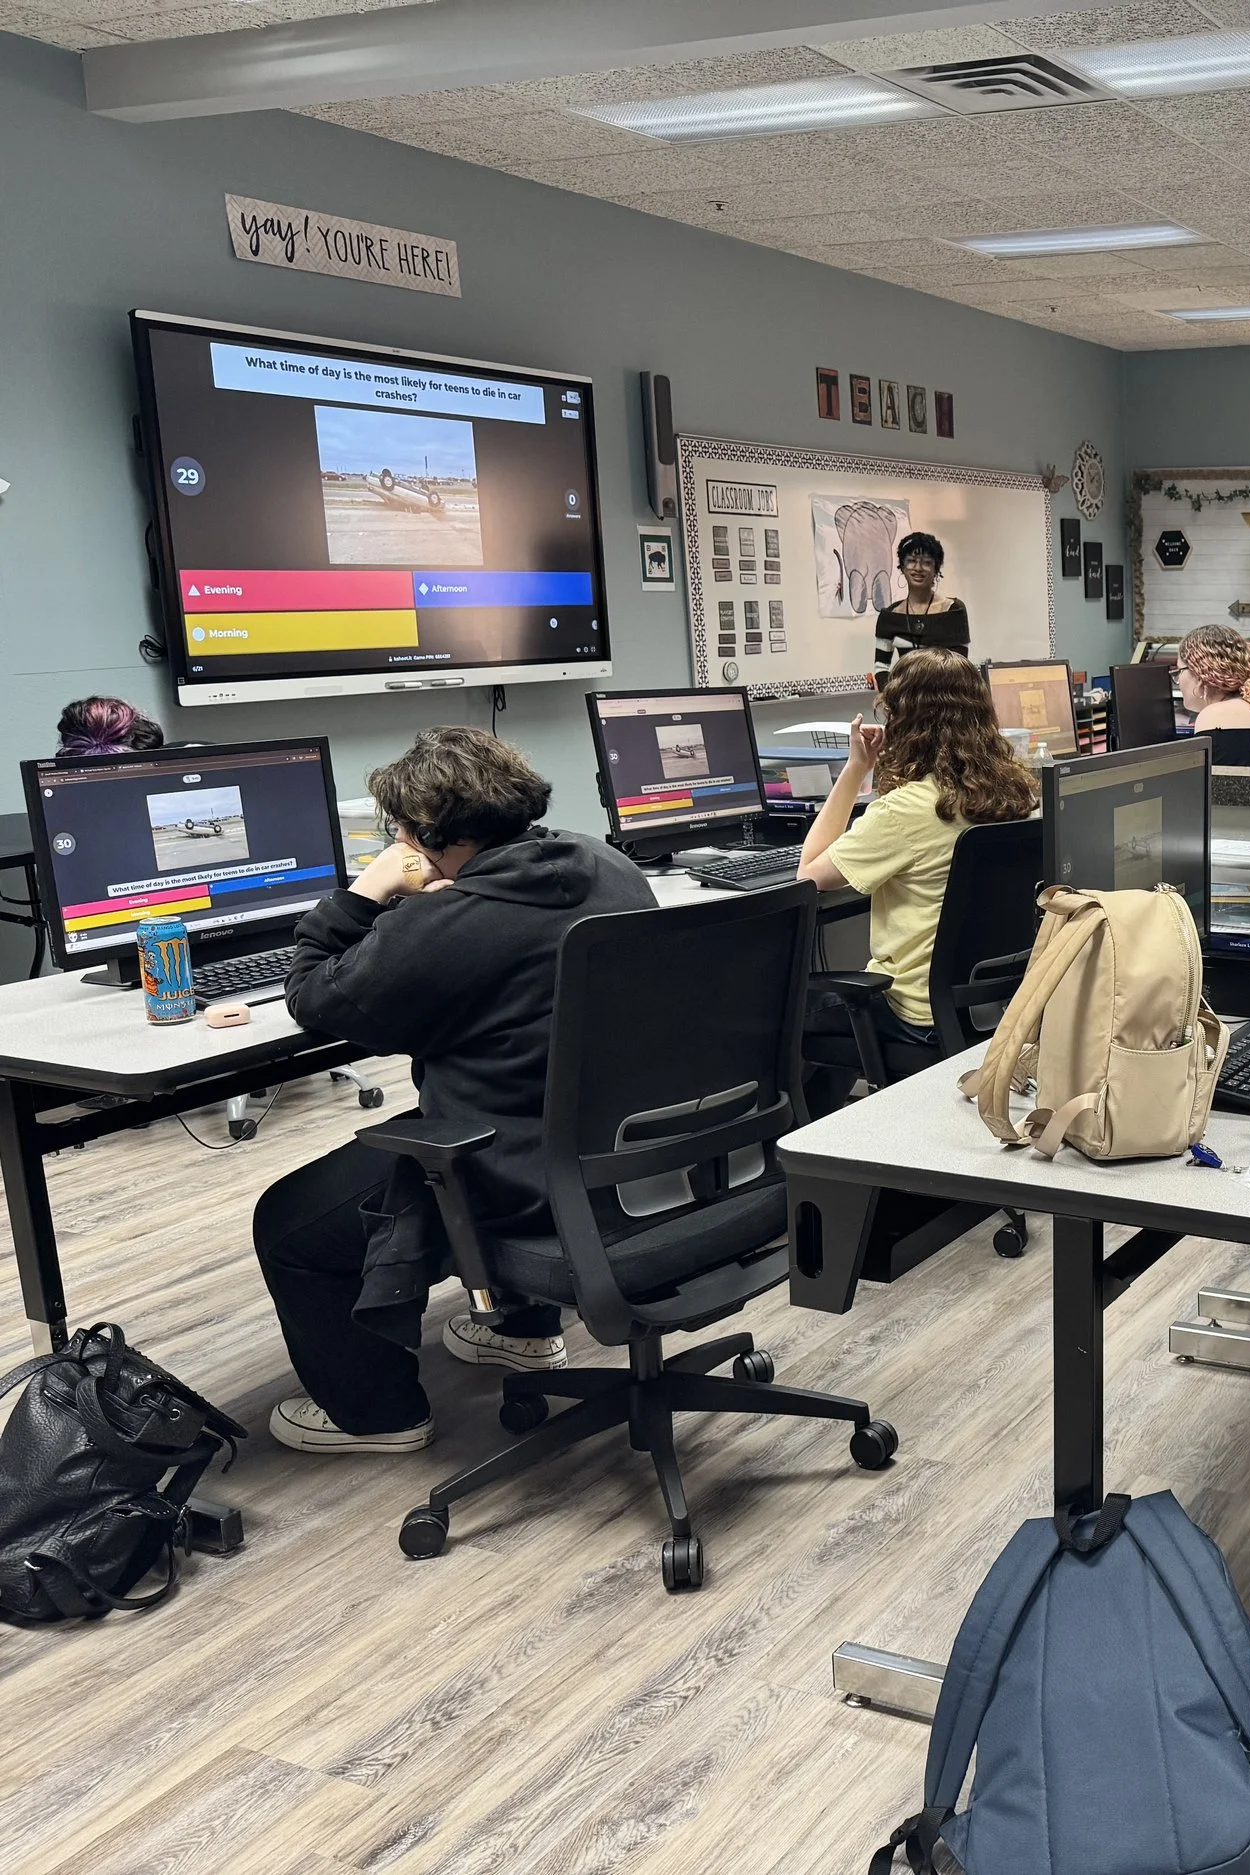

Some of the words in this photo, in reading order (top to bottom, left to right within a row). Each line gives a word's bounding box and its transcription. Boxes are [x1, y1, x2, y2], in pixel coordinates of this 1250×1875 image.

[317, 225, 390, 271] YOU'RE
[397, 242, 452, 285] HERE!
[245, 356, 278, 370] What
[280, 361, 305, 373] time
[308, 365, 320, 375] of
[321, 366, 341, 380] day
[343, 368, 352, 379] is
[354, 371, 372, 382] the
[374, 374, 400, 385] most
[401, 376, 427, 390] likely
[429, 380, 443, 391] for
[444, 383, 470, 394] teens
[471, 386, 481, 396] to
[482, 387, 496, 398] die
[497, 388, 506, 400] in
[507, 392, 521, 401] car
[375, 390, 418, 402] crashes?
[820, 373, 953, 437] TEAC
[176, 468, 199, 485] 29
[712, 486, 754, 511] CLASSROOM
[758, 489, 774, 511] JOBS
[204, 585, 243, 597] Evening
[431, 584, 468, 593] Afternoon
[208, 628, 248, 639] Morning
[56, 839, 72, 849] 30
[270, 861, 293, 869] crashes?
[1063, 862, 1072, 874] 30
[200, 929, 234, 940] lenovo
[160, 989, 196, 1000] JUICE
